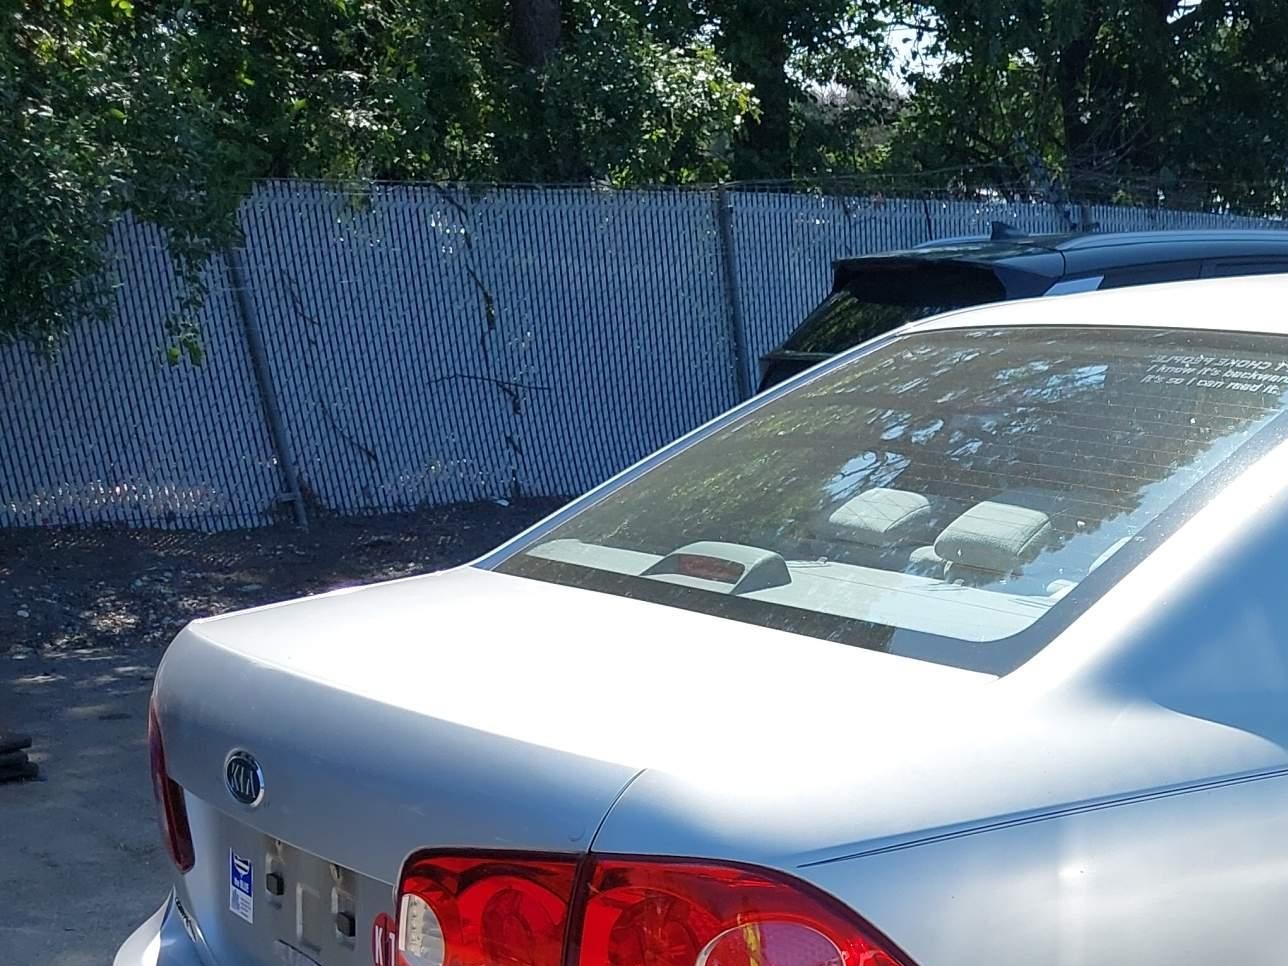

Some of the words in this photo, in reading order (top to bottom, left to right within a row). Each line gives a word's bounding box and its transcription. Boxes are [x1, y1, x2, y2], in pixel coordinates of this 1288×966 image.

[1156, 364, 1198, 375] know
[1165, 377, 1185, 385] so
[1196, 379, 1225, 389] can
[1225, 381, 1263, 392] read
[230, 761, 257, 799] KIA
